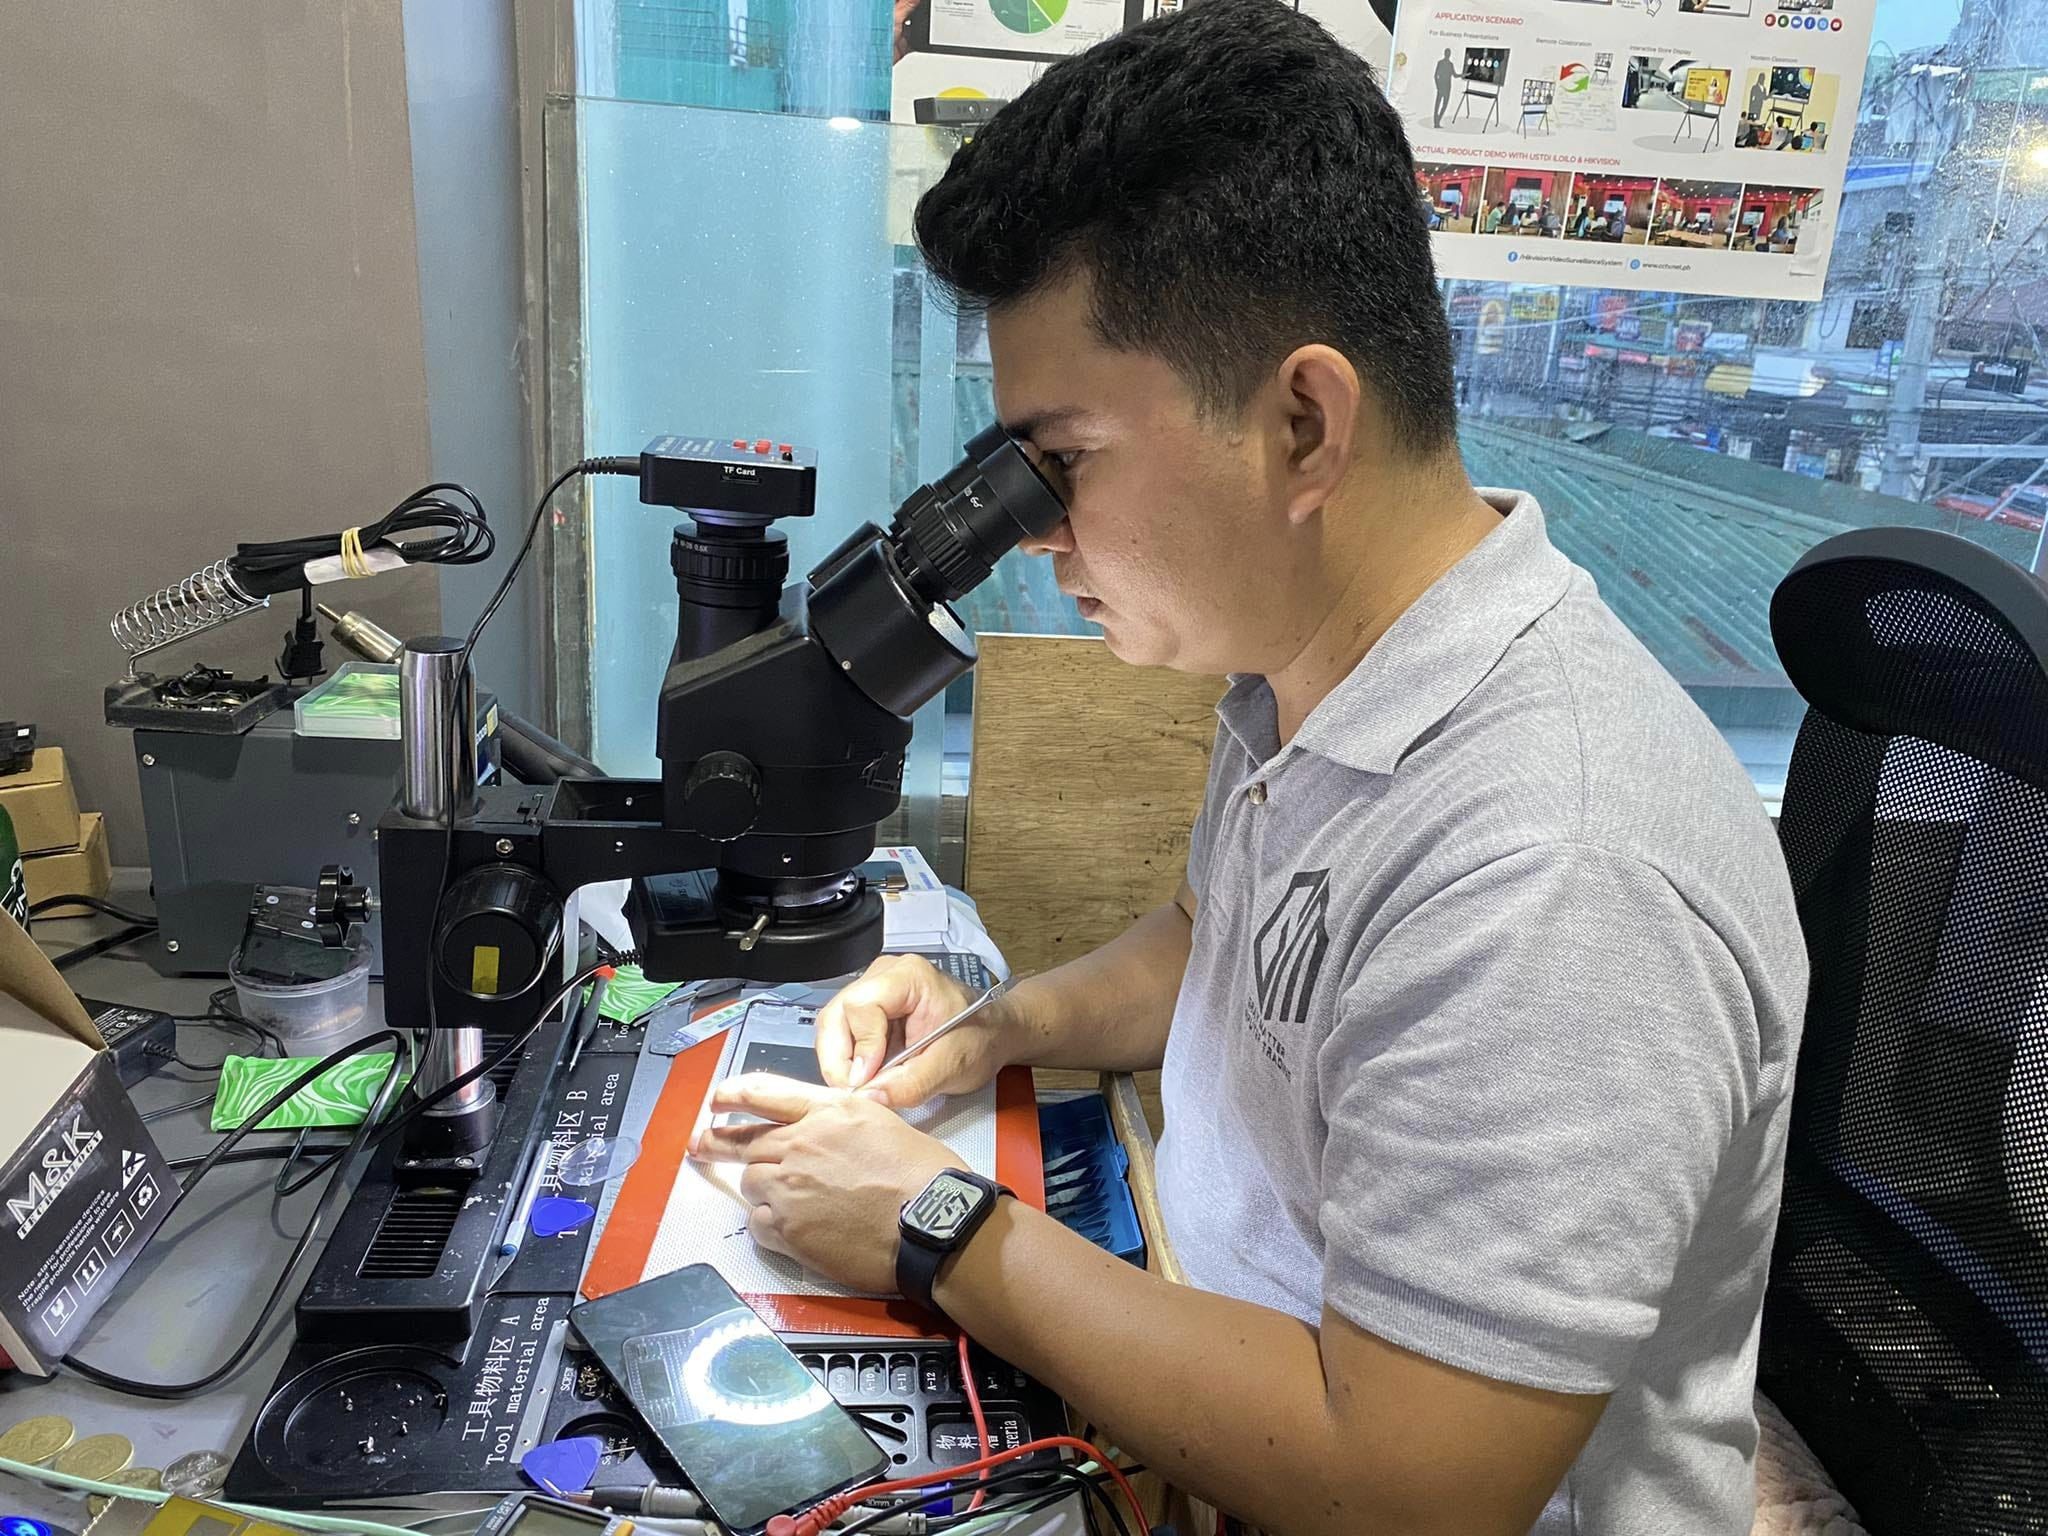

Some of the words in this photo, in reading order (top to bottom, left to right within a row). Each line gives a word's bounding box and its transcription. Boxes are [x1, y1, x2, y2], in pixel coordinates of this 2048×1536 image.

[1435, 12, 1484, 22] APPLICATION
[1485, 16, 1523, 25] SCENARIO
[1416, 146, 1445, 154] ACTUAL
[1447, 147, 1483, 157] PRODUCT
[1484, 150, 1507, 158] DEMO
[1508, 152, 1528, 160] WITH
[1583, 157, 1621, 165] HIKVISION
[724, 466, 735, 474] TF
[736, 467, 756, 476] Card
[566, 1090, 588, 1101] B
[600, 1072, 620, 1106] area
[6, 1113, 96, 1225] M&K
[18, 1130, 103, 1239] TECHNOLOGY
[22, 1290, 34, 1307] the
[33, 1272, 50, 1294] need
[50, 1258, 60, 1272] for
[59, 1215, 94, 1263] professional
[100, 1192, 111, 1207] use
[37, 1254, 55, 1277] static
[54, 1219, 82, 1254] sensitive
[82, 1190, 105, 1219] devices
[26, 1284, 50, 1313] Fragile
[49, 1250, 76, 1285] products
[75, 1223, 96, 1251] handle
[95, 1208, 107, 1224] with
[106, 1191, 119, 1209] care
[461, 1336, 516, 1442] 工具物料区
[501, 1315, 520, 1326] A
[486, 1423, 513, 1465] Tool
[506, 1339, 538, 1413] material
[530, 1297, 550, 1331] area
[865, 1373, 876, 1392] A-10
[897, 1373, 907, 1392] A-11
[926, 1372, 937, 1392] A-12
